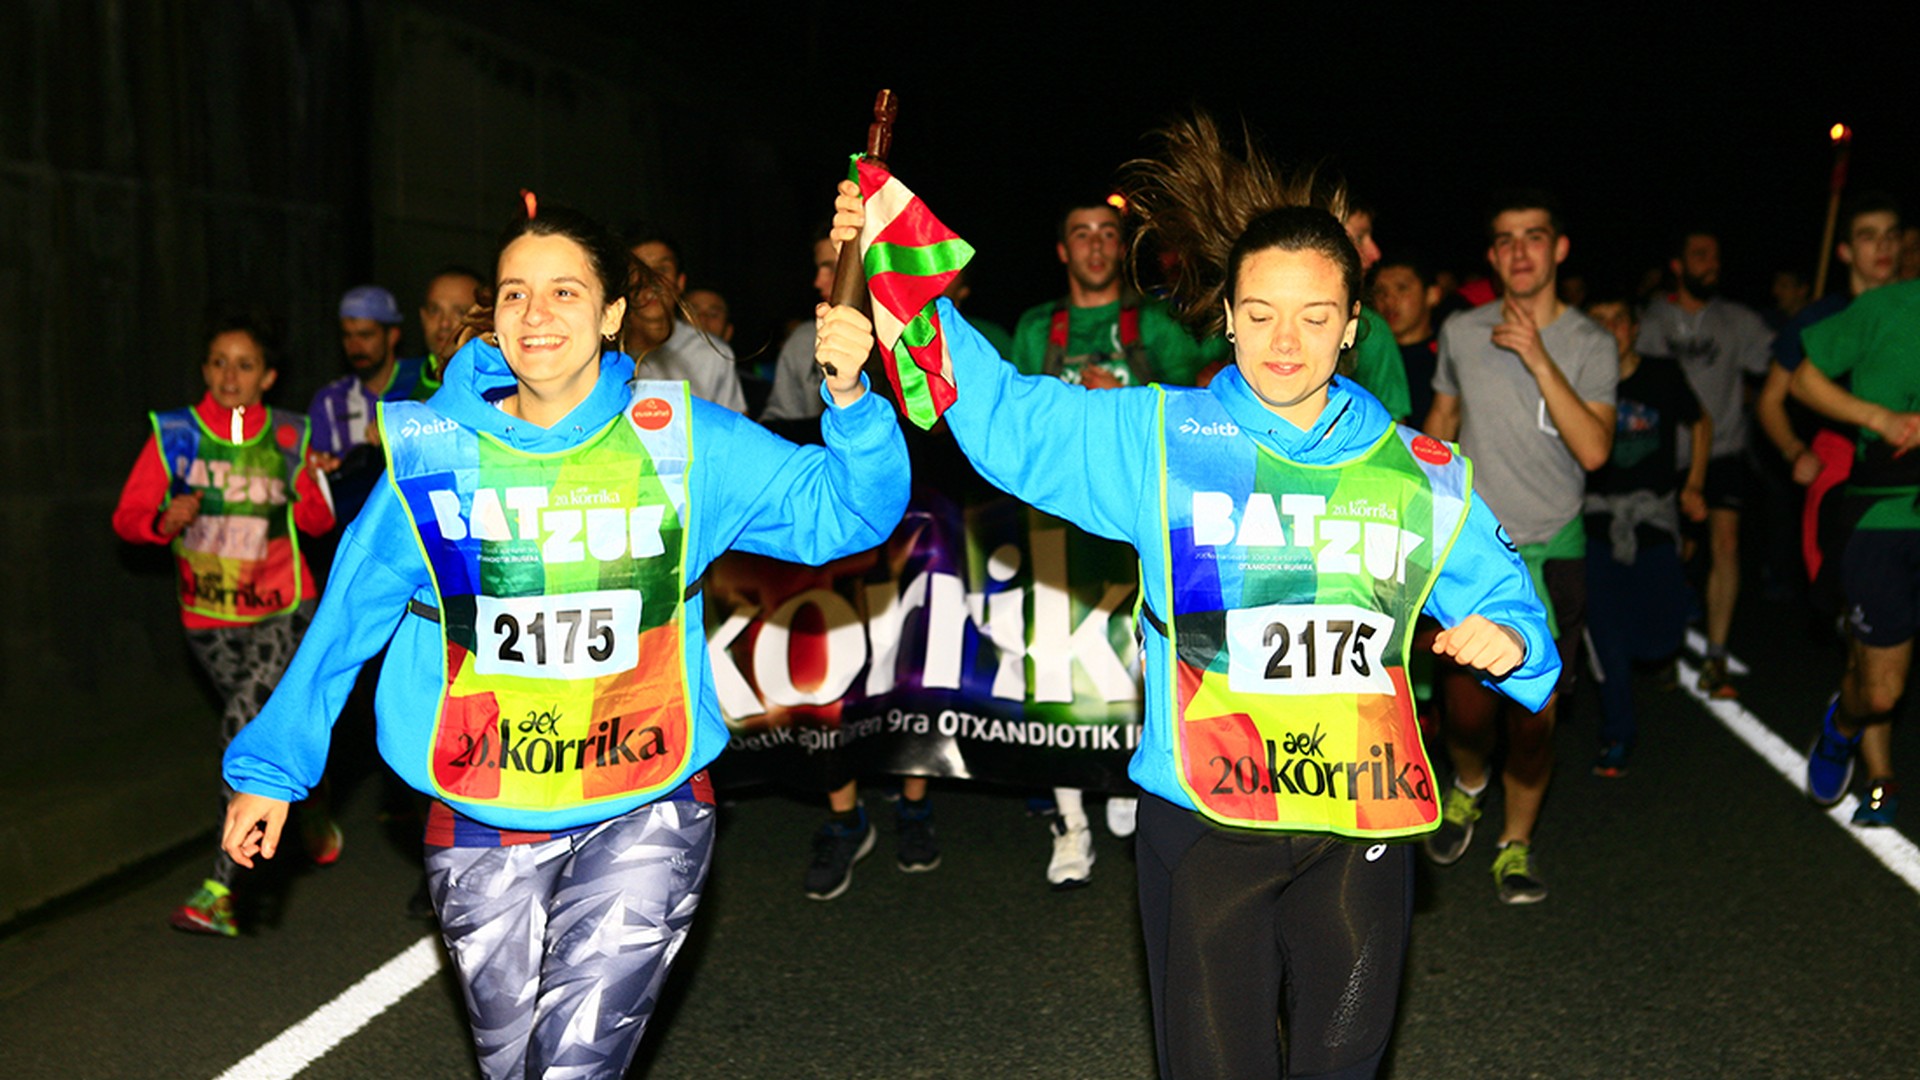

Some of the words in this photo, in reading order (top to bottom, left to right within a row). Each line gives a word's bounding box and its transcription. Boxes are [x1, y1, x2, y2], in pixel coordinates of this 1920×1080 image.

[422, 417, 459, 435] eitb
[1201, 421, 1239, 437] eitb
[428, 487, 549, 541] BAT
[542, 504, 666, 564] ZUK
[1192, 491, 1327, 547] BAT
[494, 608, 615, 665] 2175
[1262, 620, 1377, 680] 2175
[518, 704, 562, 736] aek
[887, 709, 930, 735] 9ra
[937, 710, 1120, 750] OTXANDIOTIK
[1282, 722, 1327, 758] aek
